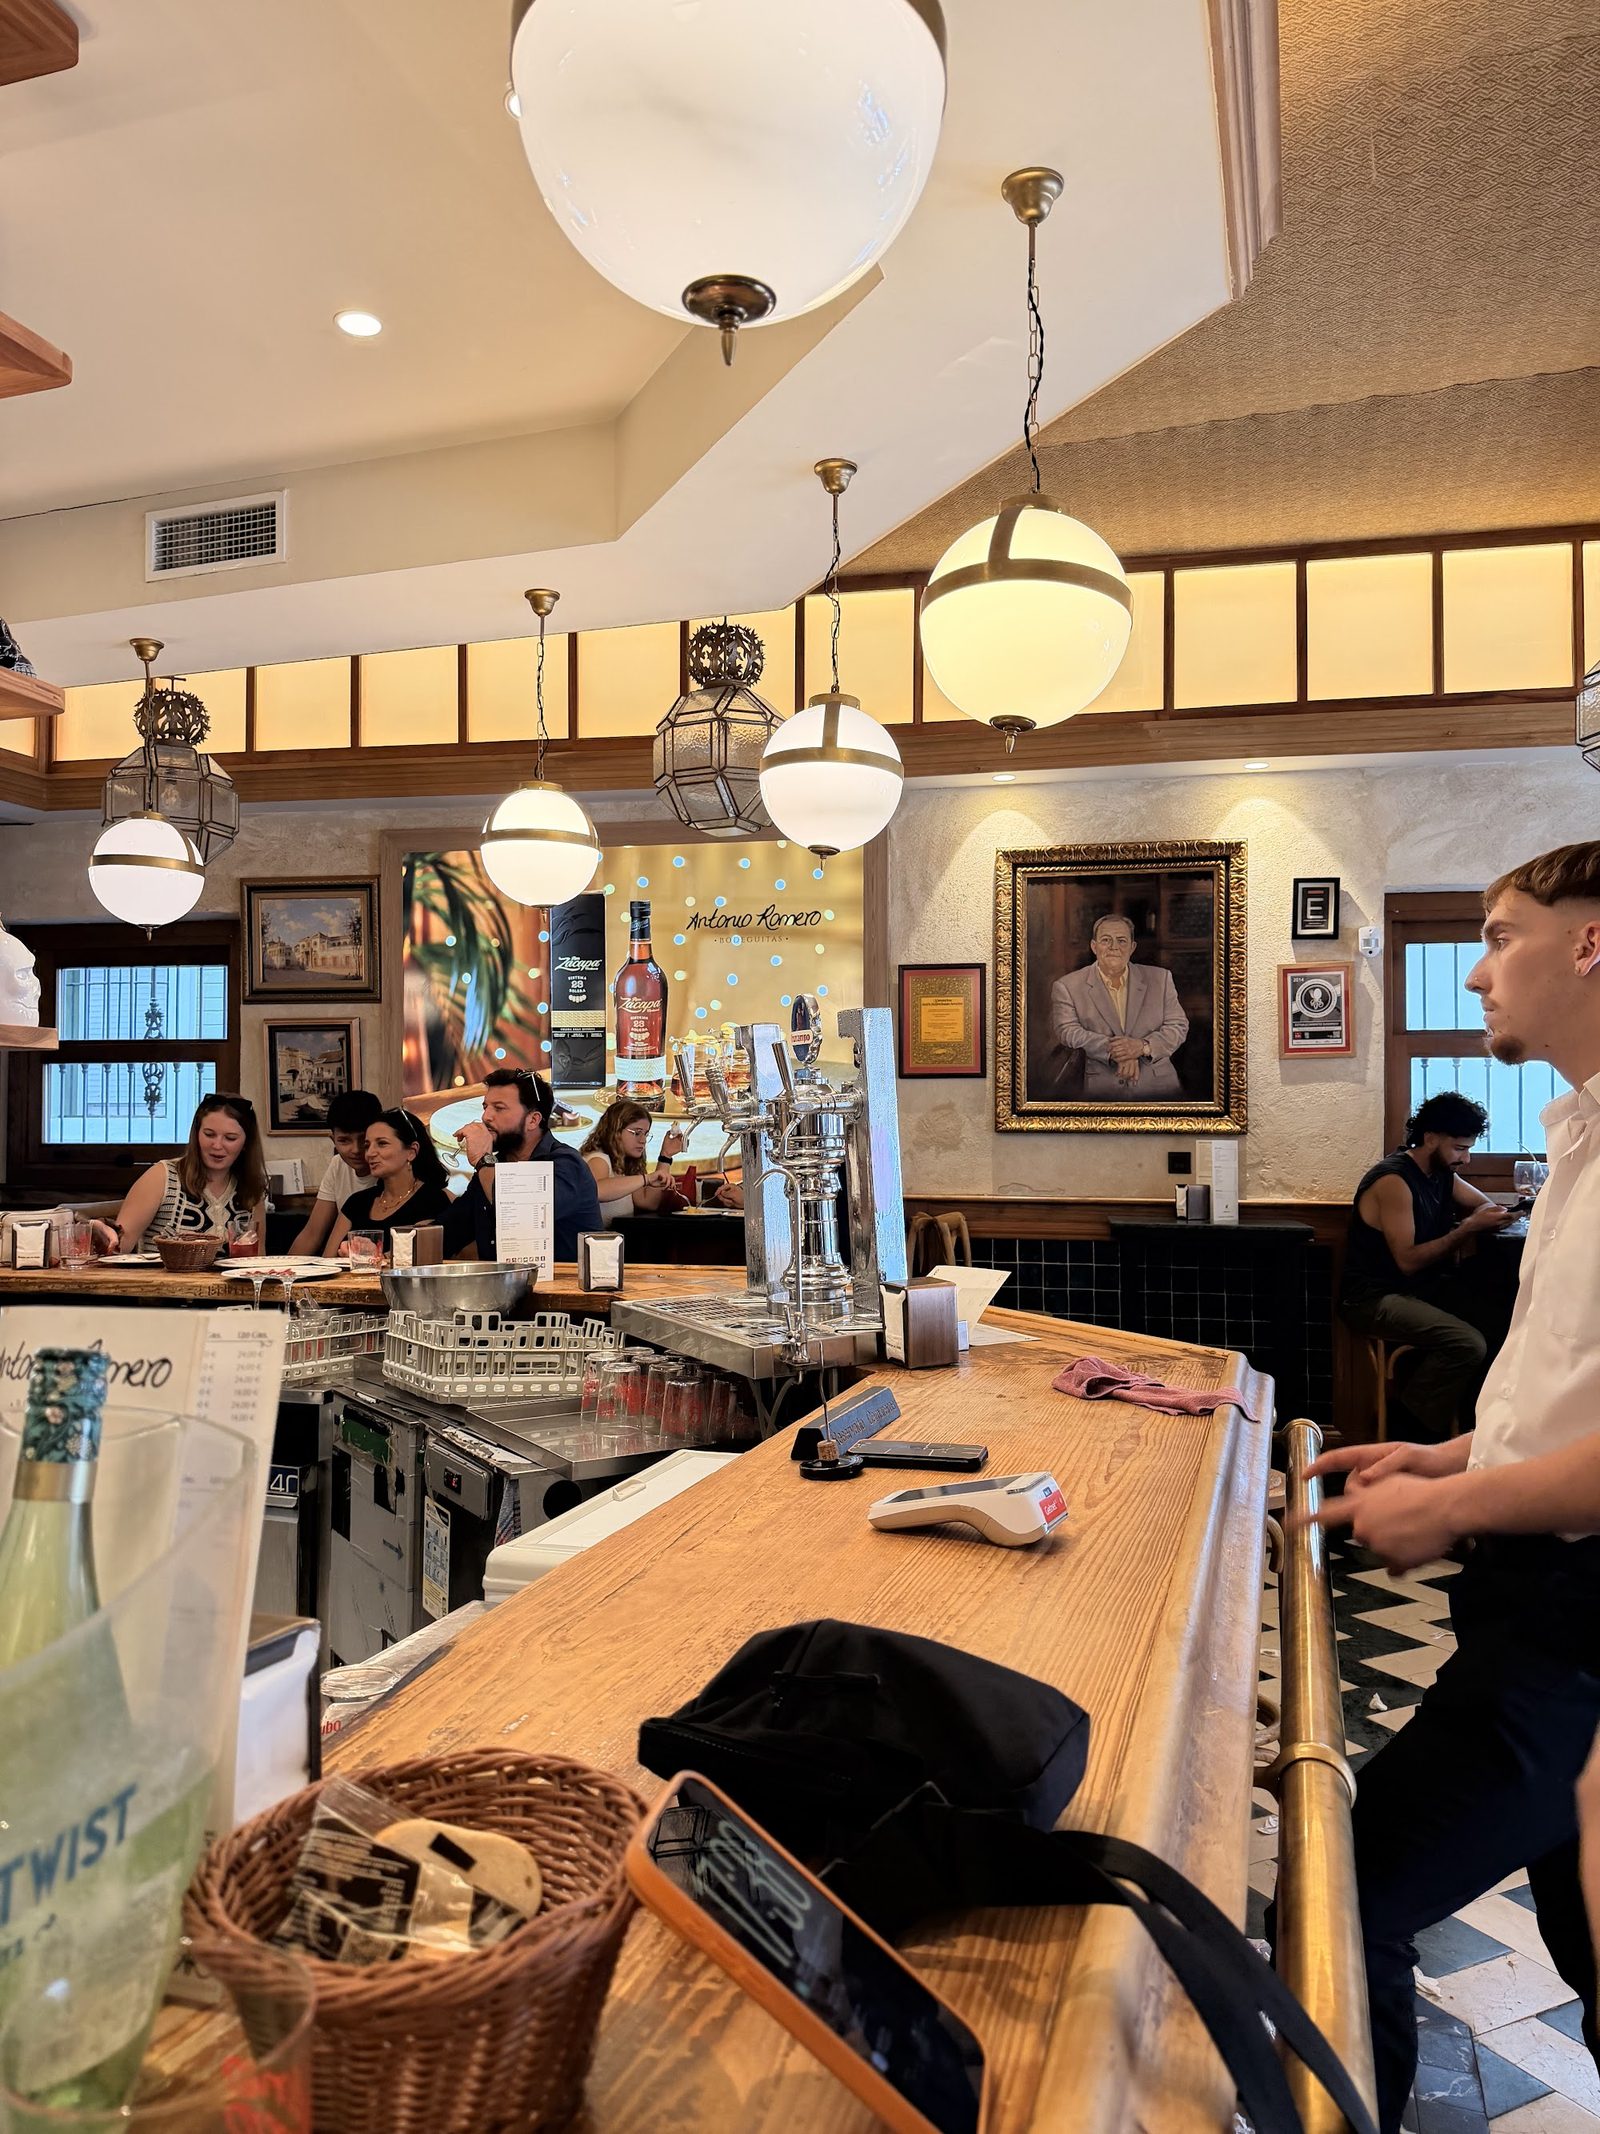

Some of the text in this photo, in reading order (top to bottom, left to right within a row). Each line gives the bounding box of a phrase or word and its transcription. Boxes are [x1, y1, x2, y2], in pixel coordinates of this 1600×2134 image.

[686, 904, 822, 931] Antonio Romero
[555, 957, 602, 972] Zacapa
[618, 996, 663, 1013] Zacapa
